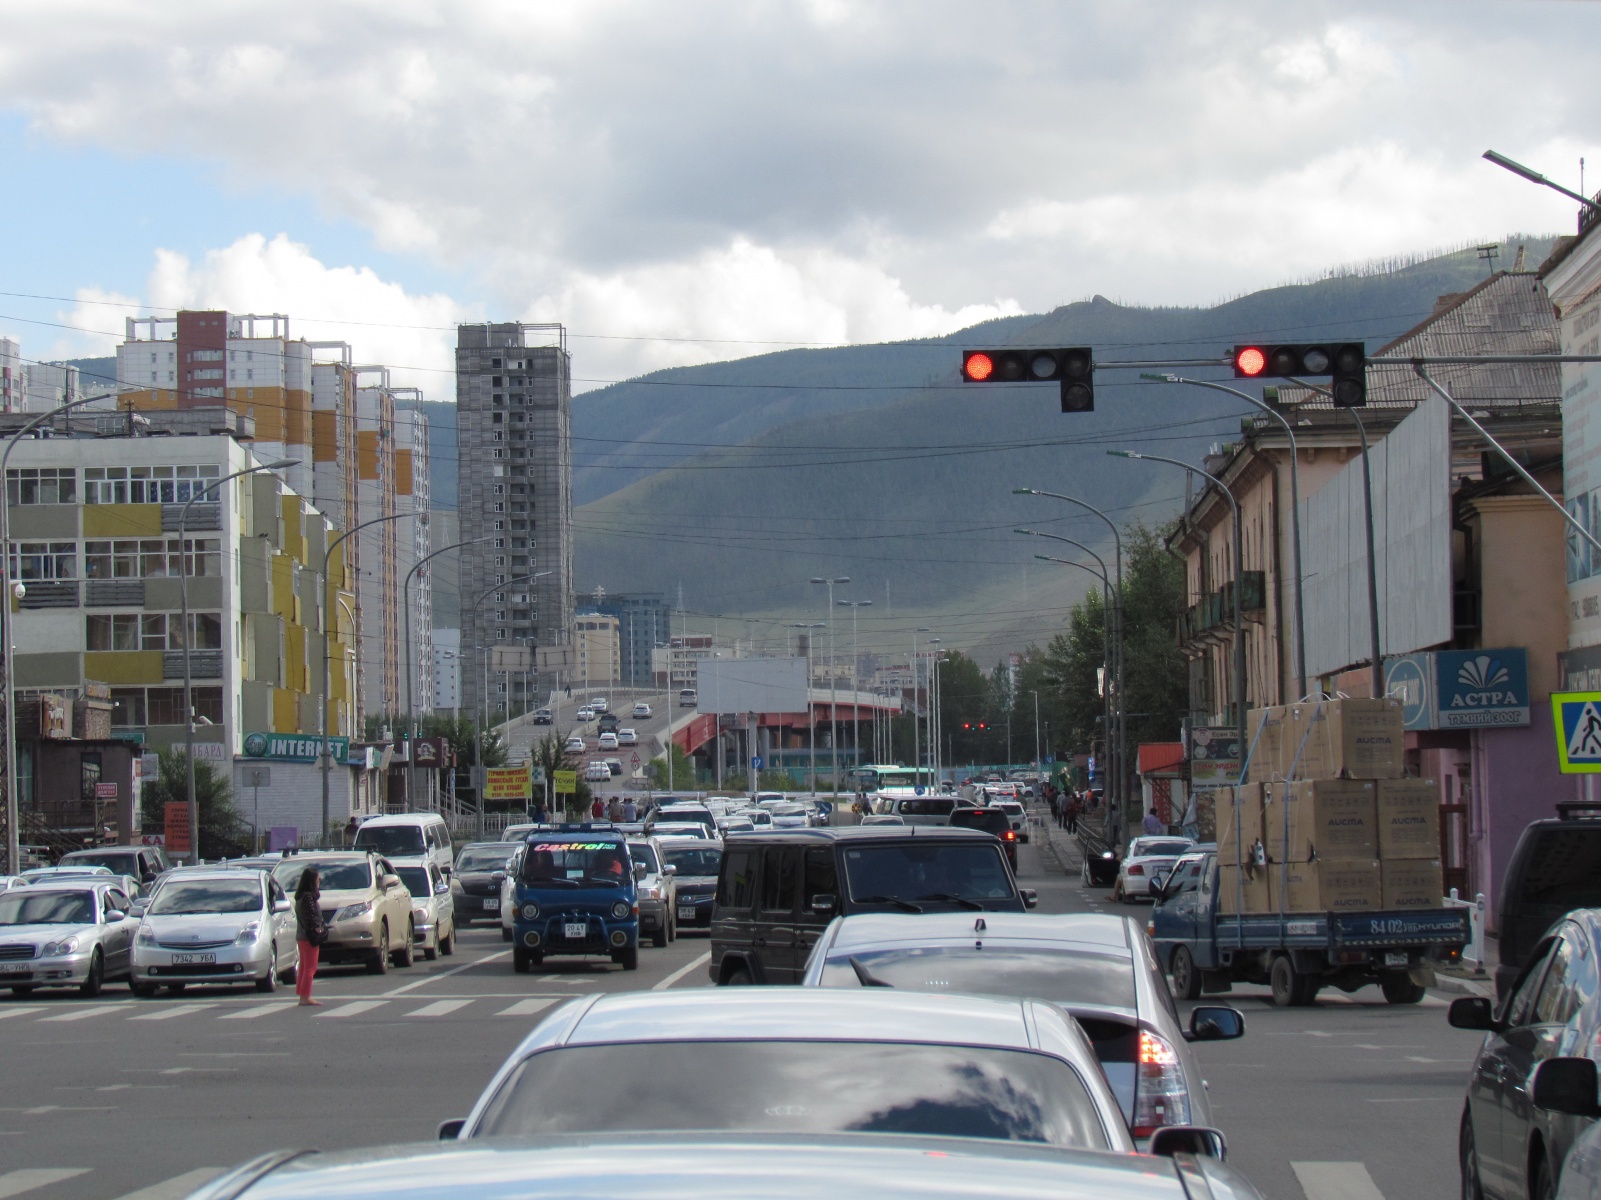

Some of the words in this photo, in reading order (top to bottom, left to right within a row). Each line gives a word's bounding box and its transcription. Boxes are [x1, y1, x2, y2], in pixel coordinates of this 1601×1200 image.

[1450, 691, 1519, 708] АСТРА
[1493, 710, 1521, 724] ЗООГ
[1356, 737, 1392, 745] AUCMA
[1328, 818, 1364, 826] AUCMA
[1391, 817, 1427, 825] AUCMA
[534, 842, 605, 852] Castrol
[1333, 899, 1369, 907] AUCMA
[1370, 919, 1385, 934] 84
[1388, 919, 1403, 934] 02
[175, 955, 193, 963] 7342
[200, 954, 214, 962] УБЛ
